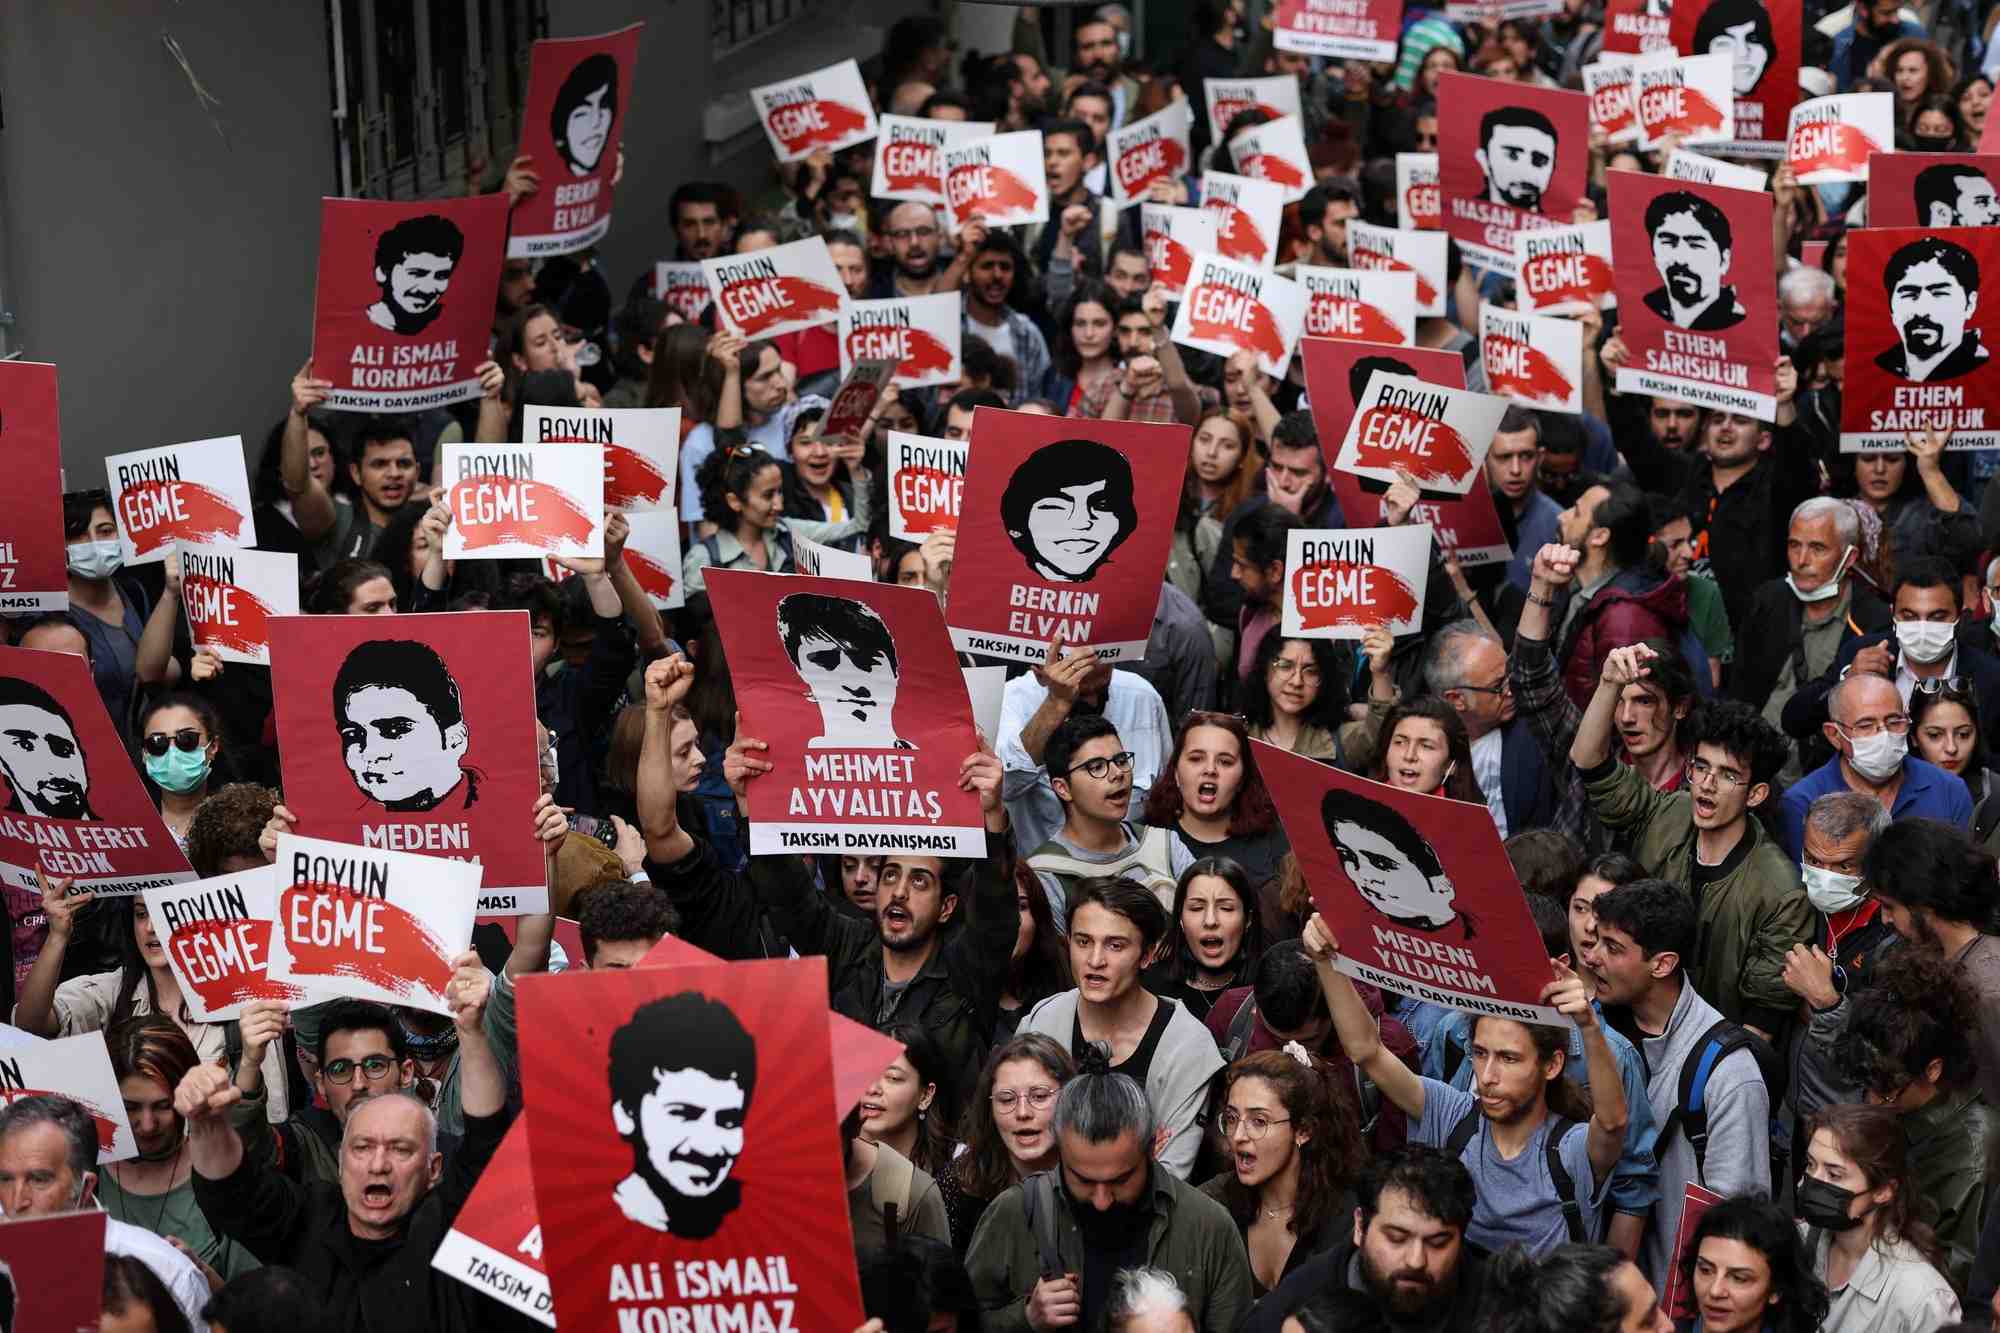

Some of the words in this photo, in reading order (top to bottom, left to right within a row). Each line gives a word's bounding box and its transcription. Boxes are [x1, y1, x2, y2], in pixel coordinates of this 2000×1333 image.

[716, 255, 779, 289] BOYUN
[1202, 263, 1264, 299] BOYUN
[1306, 276, 1360, 299] BOYUN
[725, 278, 795, 323] EĞME
[1664, 330, 1727, 358] ETHEM
[351, 362, 456, 388] KORKMAZ
[1376, 384, 1450, 421] BOYUN
[1894, 386, 1964, 409] ETHEM
[539, 416, 614, 444] BOYUN
[118, 453, 180, 492] BOYUN
[457, 452, 534, 481] BOYUN
[901, 444, 966, 479] BOYUN
[124, 483, 190, 533] EĞME
[460, 482, 540, 526] EĞME
[901, 473, 965, 517] EĞME
[183, 551, 235, 586] BOYUN
[1302, 537, 1374, 569] BOYUN
[183, 578, 239, 627] EĞME
[1301, 568, 1377, 607] EĞME
[1008, 611, 1093, 643] ELVAN
[804, 754, 917, 784] MEHMET
[789, 786, 943, 824] AYVALITAŞ
[845, 833, 957, 850] DAYANIŞMASI
[293, 851, 388, 900] BOYUN
[161, 884, 249, 935] BOYUN
[291, 893, 386, 954] EĞME
[176, 923, 267, 984] EĞME
[1372, 946, 1498, 994] YILDIRIM
[617, 1299, 800, 1333] KORKMAZ
